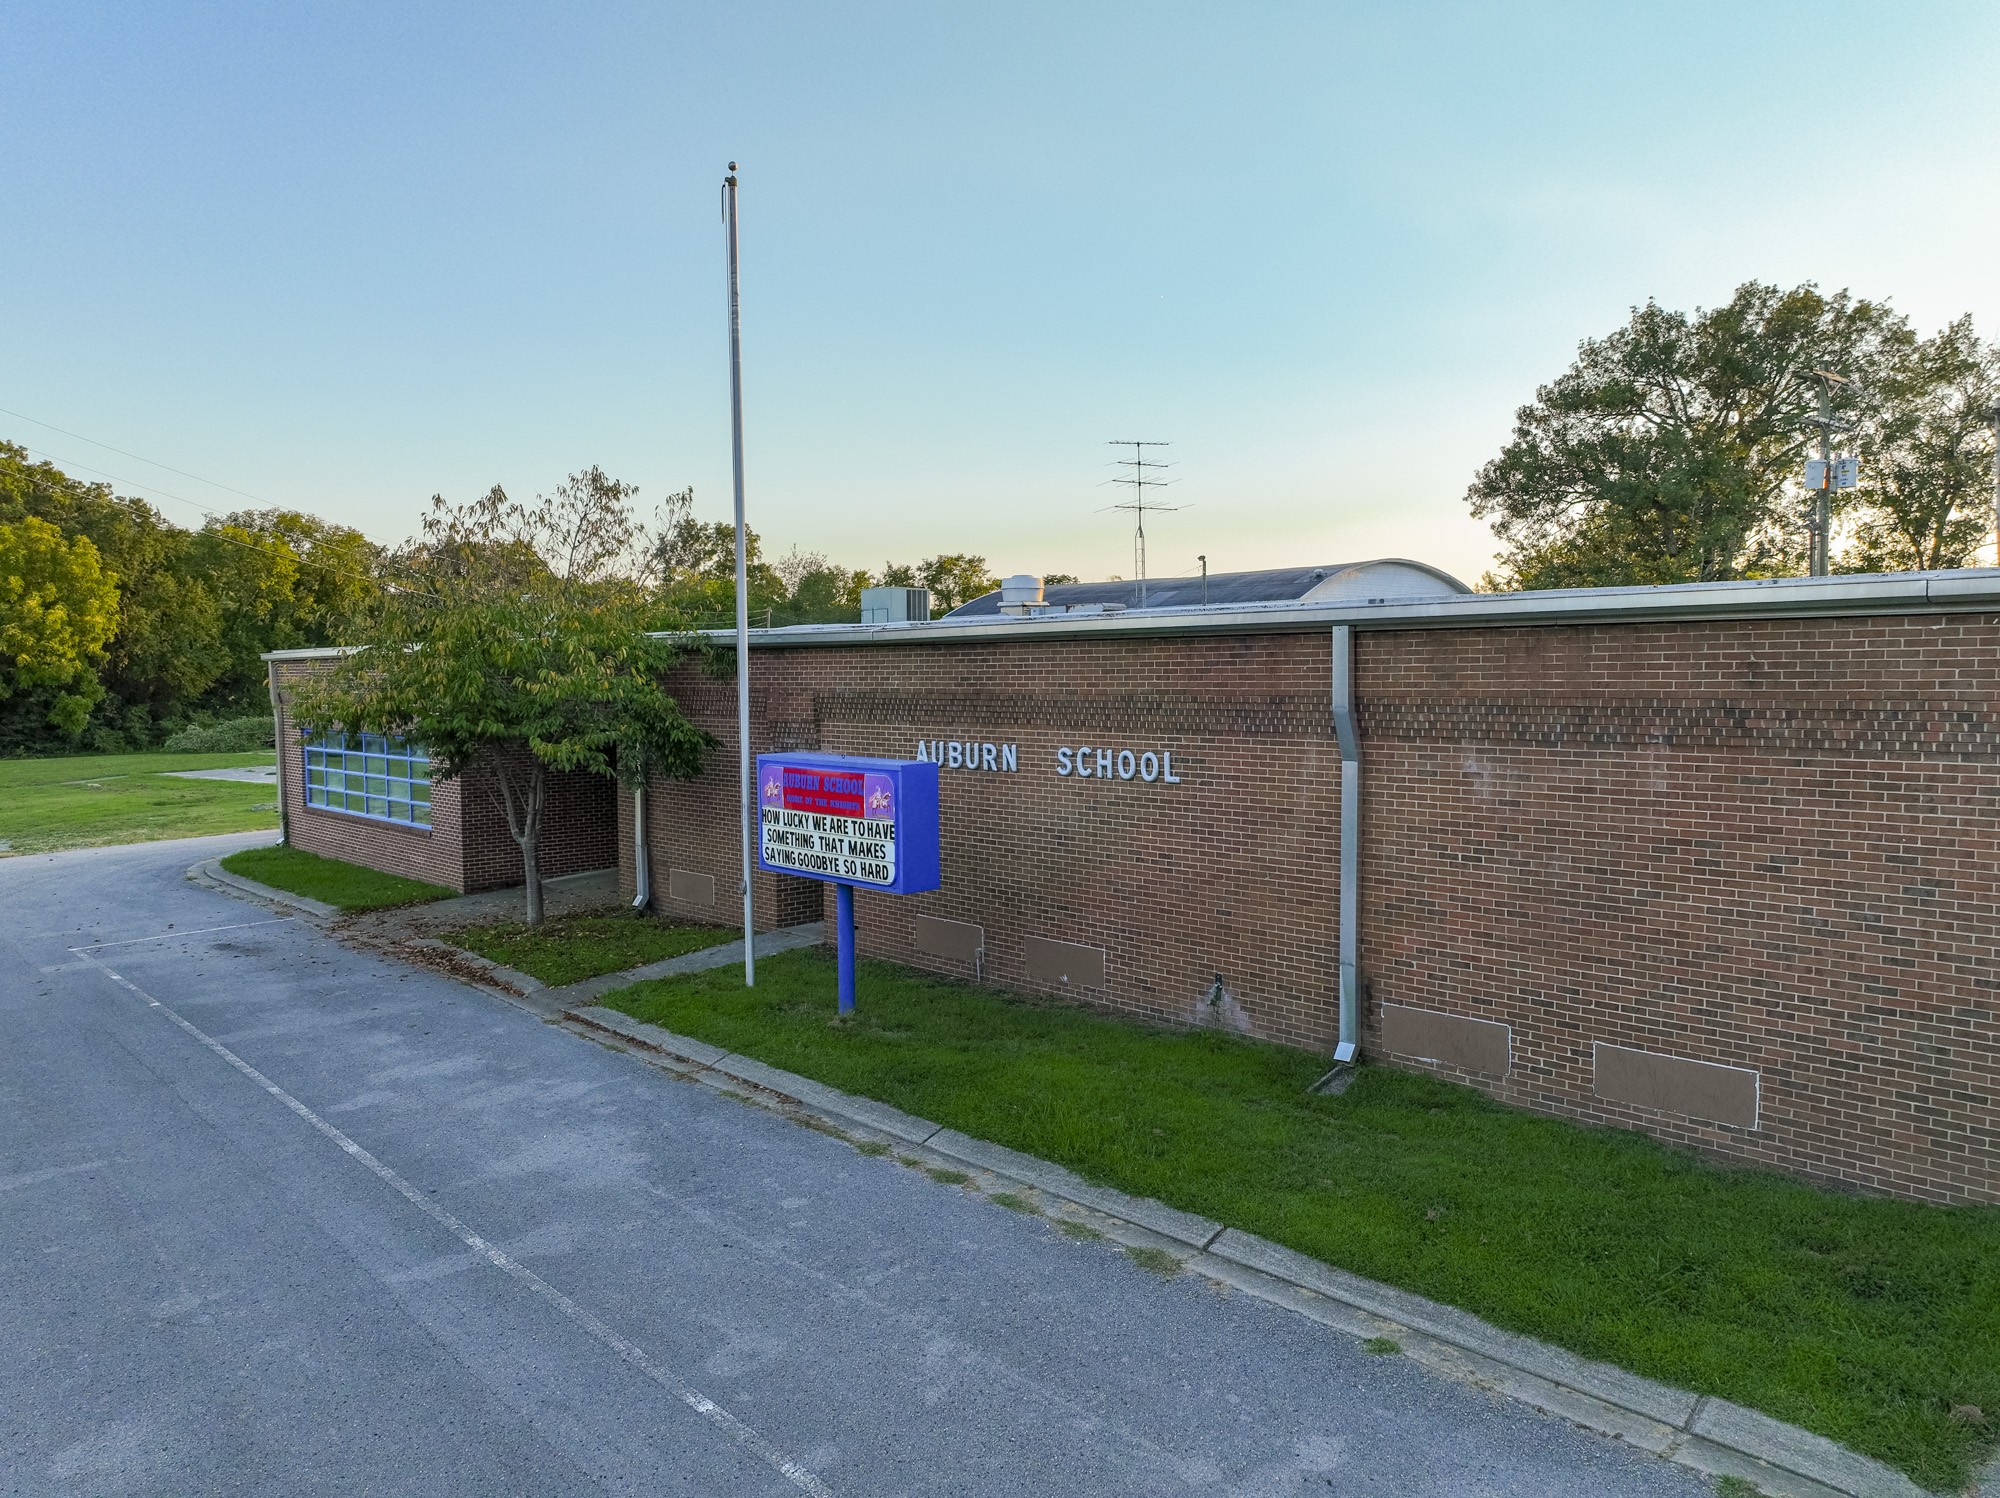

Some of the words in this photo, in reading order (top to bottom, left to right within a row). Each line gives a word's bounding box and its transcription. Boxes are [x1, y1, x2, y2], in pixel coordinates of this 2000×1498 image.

[916, 740, 1018, 772] AUBURN
[1057, 747, 1181, 783] SCHOOL
[783, 772, 820, 790] AUBURN
[824, 776, 864, 795] SCHOOL
[815, 798, 828, 807] THE
[762, 809, 780, 825] HOW
[783, 812, 809, 829] LUCKY
[813, 816, 827, 831] WE
[829, 819, 848, 835] ARE
[852, 821, 865, 836] TO
[867, 823, 895, 840] HAVE
[767, 829, 814, 849] SOMETHING
[819, 836, 844, 853] THAT
[848, 840, 886, 859] MAKES
[765, 847, 796, 865] SAYING
[798, 852, 839, 873] GOODBYE
[844, 859, 856, 874] SO
[861, 862, 889, 880] HARD
